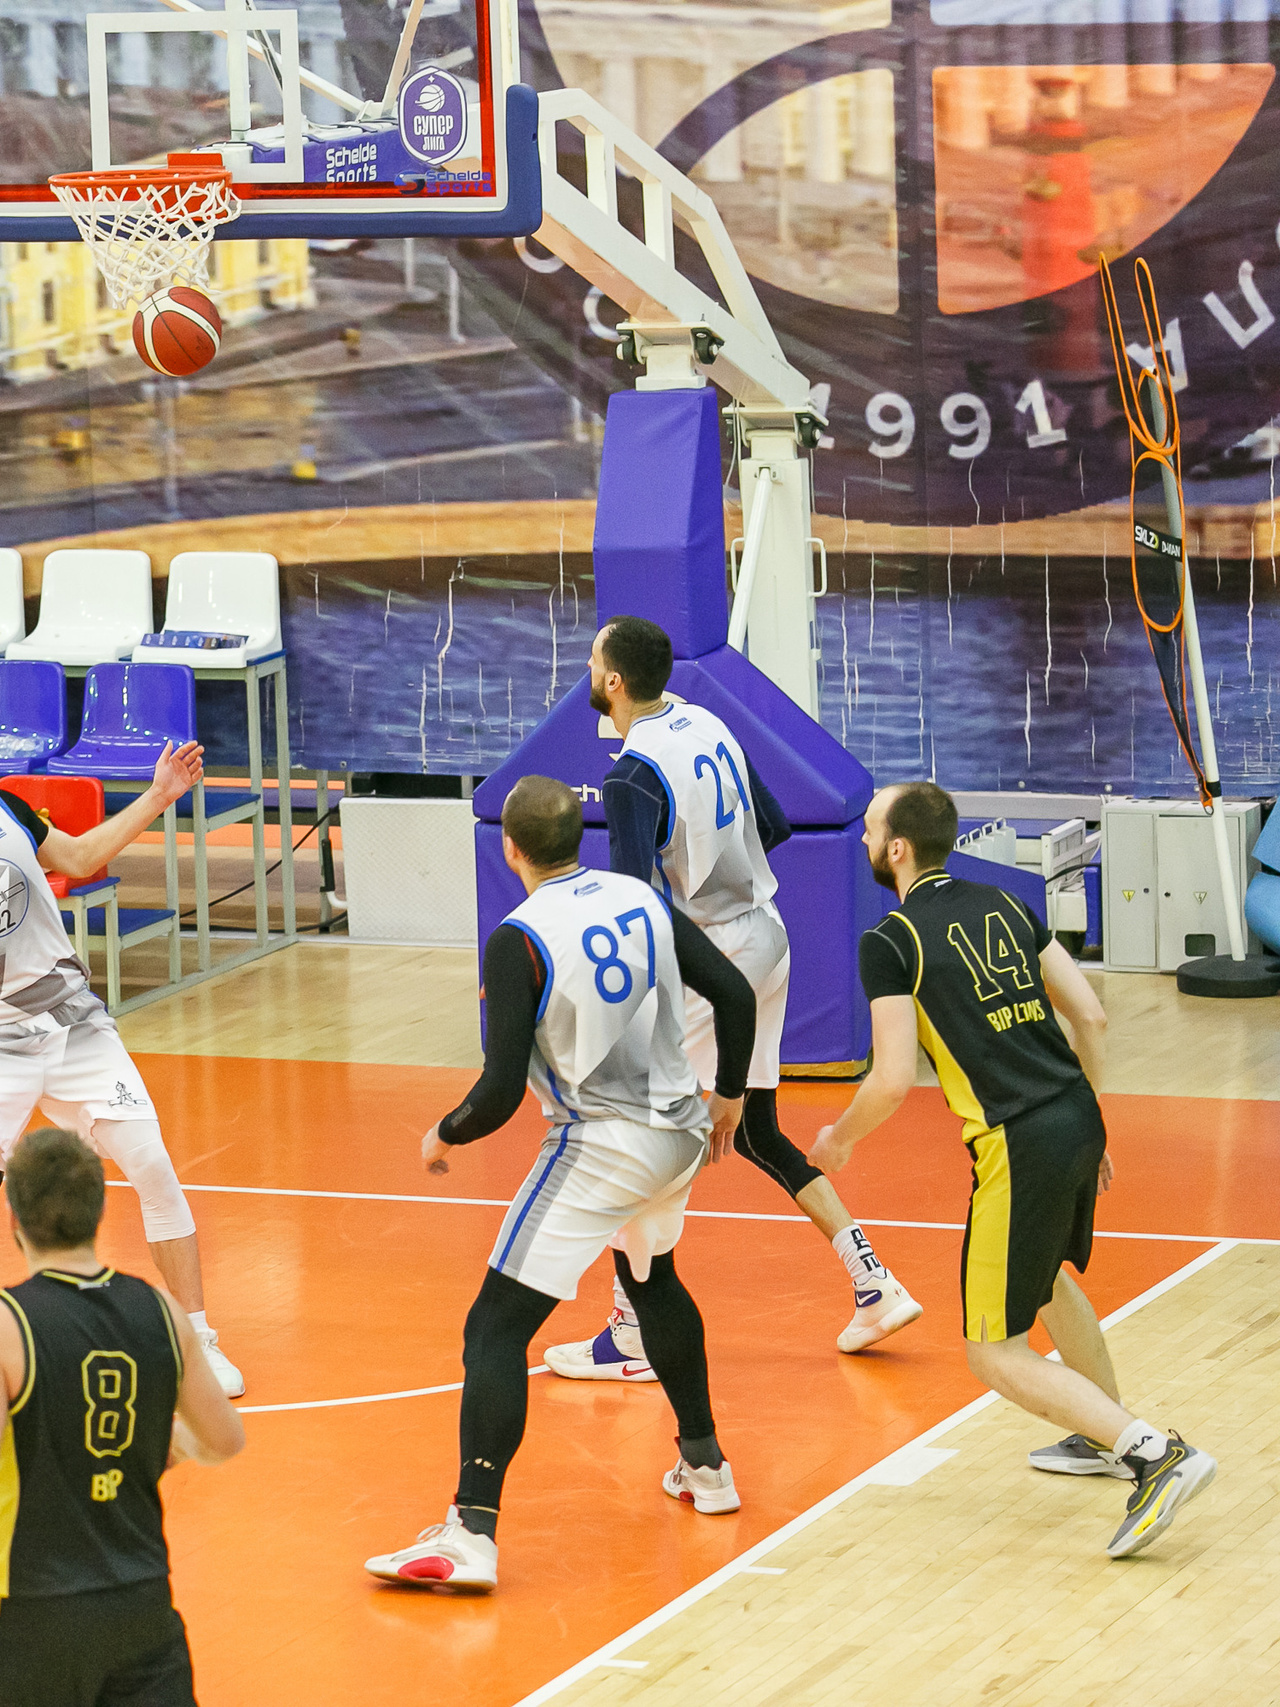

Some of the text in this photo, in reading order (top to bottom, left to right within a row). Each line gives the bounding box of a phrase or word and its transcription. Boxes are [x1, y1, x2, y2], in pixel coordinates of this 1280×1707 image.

[413, 115, 454, 136] СУПЕР
[326, 142, 377, 169] Schelde
[422, 136, 445, 151] ЛИГА
[426, 170, 492, 182] Schelde
[426, 182, 492, 195] Sports
[694, 741, 751, 831] 21
[582, 907, 656, 1004] 87
[947, 911, 1035, 1002] 14
[986, 1006, 1013, 1032] BIP
[81, 1350, 138, 1458] 8
